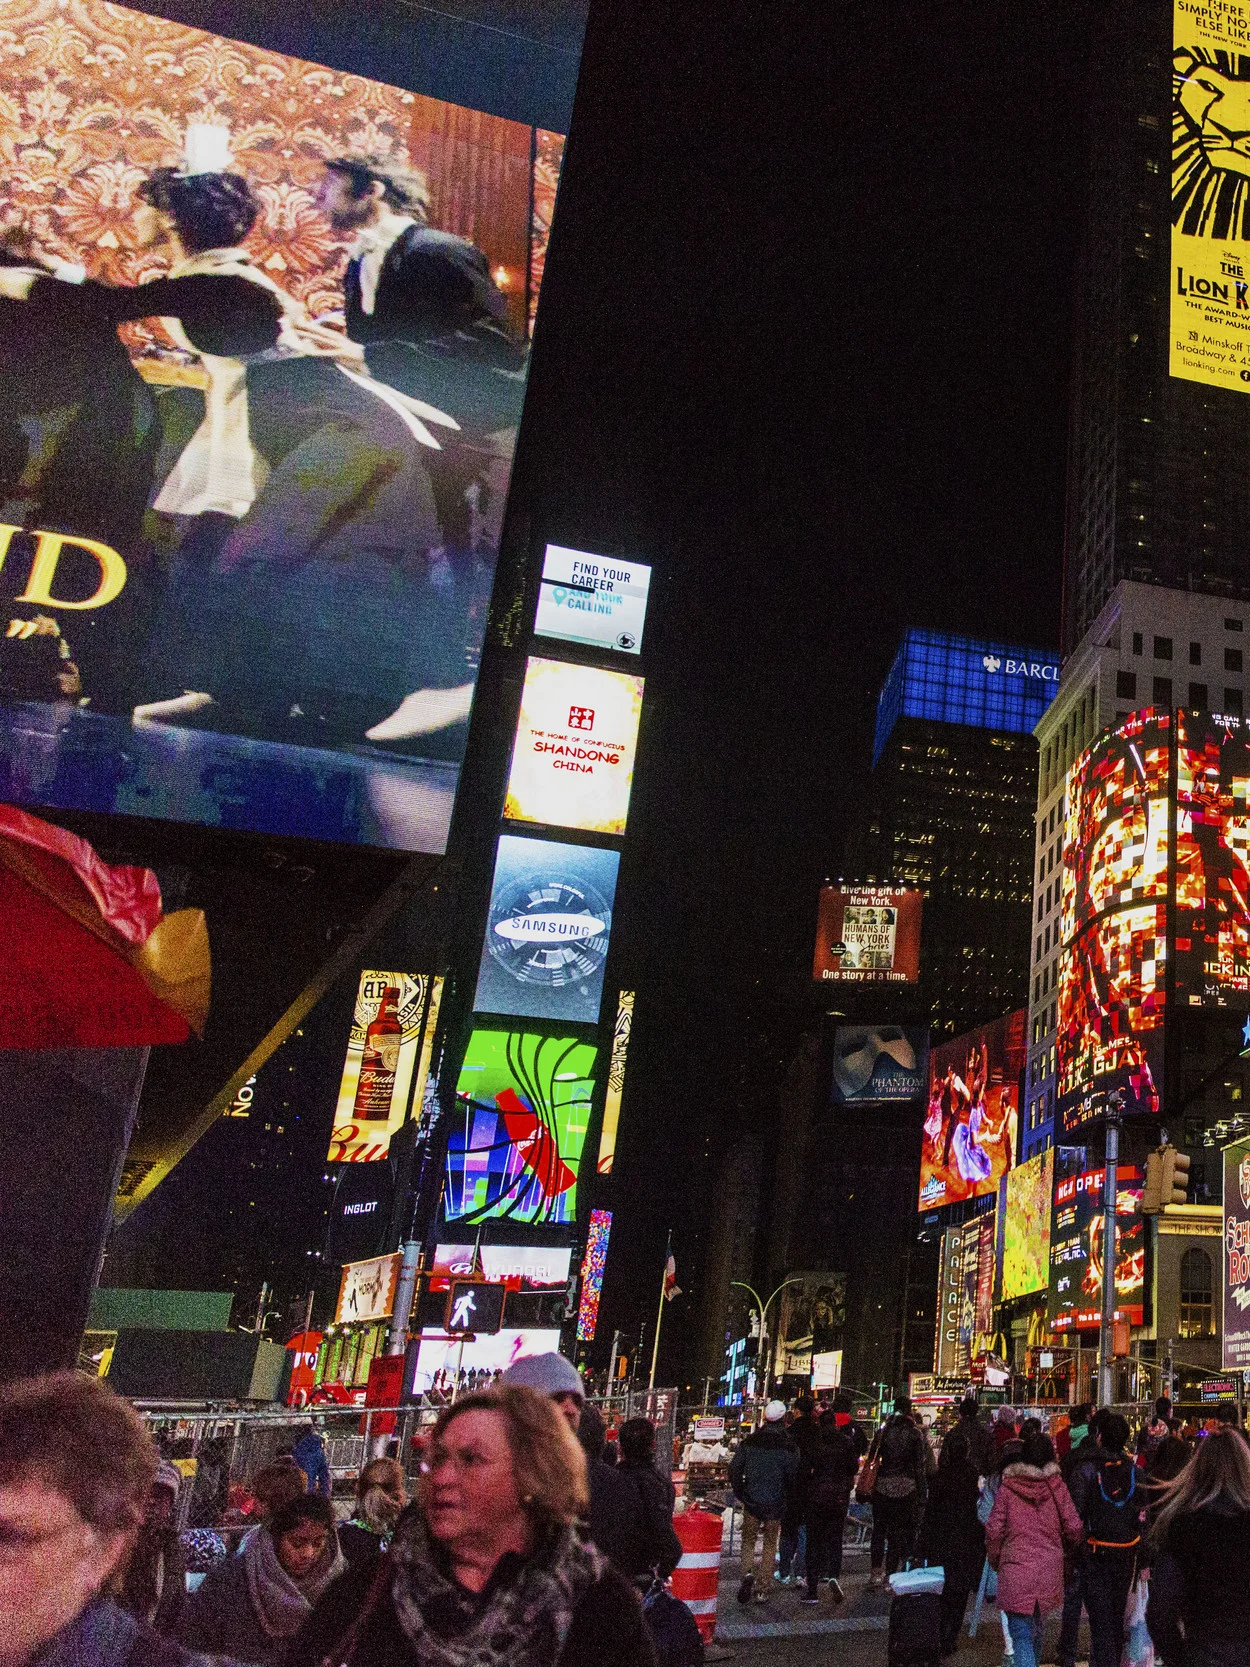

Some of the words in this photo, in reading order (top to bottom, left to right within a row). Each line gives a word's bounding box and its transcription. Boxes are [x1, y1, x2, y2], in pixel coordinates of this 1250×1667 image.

[1178, 1, 1222, 22] SIMPLY
[1195, 17, 1223, 33] ELSE
[1199, 31, 1211, 39] THE
[1213, 34, 1228, 43] NEW
[1230, 39, 1247, 49] YORK
[1220, 262, 1244, 277] THE
[1185, 300, 1203, 311] THE
[1204, 314, 1223, 325] BEST
[1176, 340, 1226, 363] Broadway
[1228, 354, 1237, 363] &
[1201, 335, 1243, 352] Minskoff
[1182, 357, 1236, 376] lionking.com
[573, 561, 599, 576] FIND
[603, 567, 631, 584] YOUR
[571, 573, 614, 592] CAREER
[567, 598, 613, 616] CALLING
[530, 729, 545, 738] THE
[547, 733, 569, 742] HOME
[584, 738, 626, 751] CONFUCIUS
[533, 741, 621, 765] SHANDONG
[552, 759, 594, 774] CHINA
[877, 886, 893, 897] gift
[850, 896, 868, 905] New
[870, 896, 893, 906] York.
[511, 917, 591, 937] SAMSUNG
[844, 924, 879, 934] HUMANS
[880, 925, 891, 934] OF
[844, 934, 865, 943] NEW
[867, 934, 890, 944] YORK
[822, 969, 840, 979] One
[841, 971, 865, 982] story
[866, 971, 876, 980] at
[886, 971, 909, 981] time.
[872, 1077, 925, 1088] PHANTOM
[1076, 1173, 1104, 1192] OPE
[344, 1201, 378, 1215] INGLOT
[945, 1236, 961, 1343] PALACE
[699, 1419, 723, 1427] DANGER
